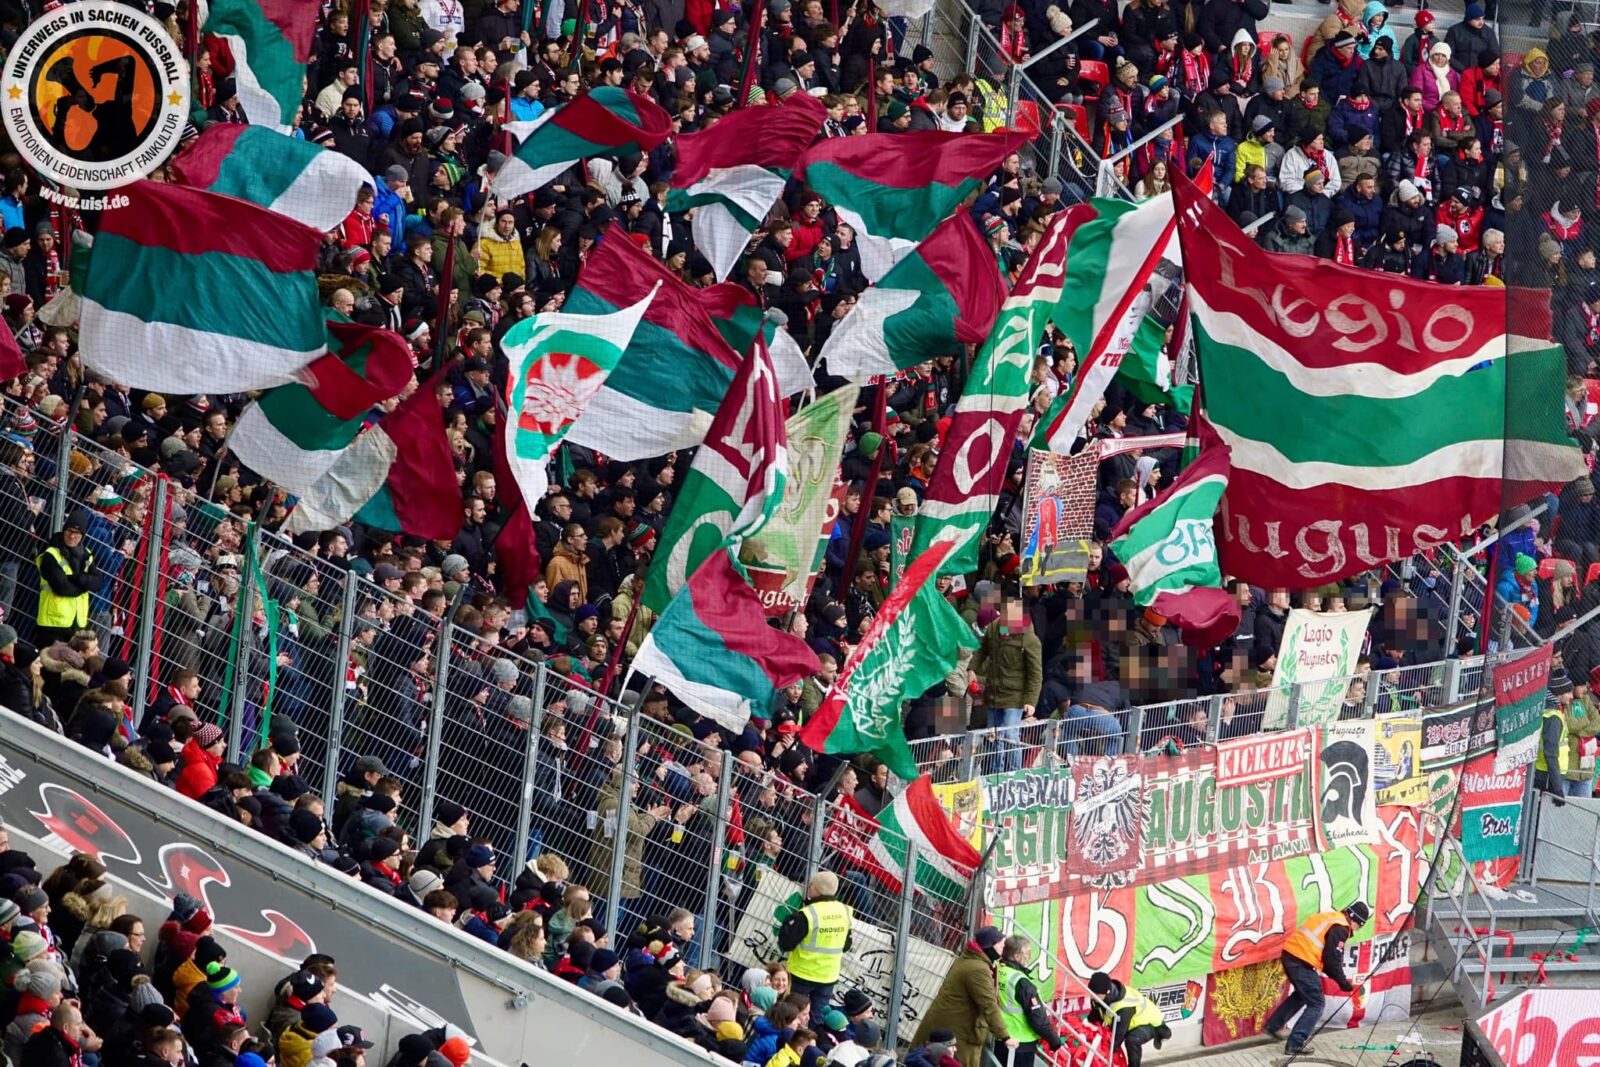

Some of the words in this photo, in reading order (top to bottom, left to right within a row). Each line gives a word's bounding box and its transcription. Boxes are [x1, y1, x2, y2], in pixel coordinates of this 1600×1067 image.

[1208, 229, 1474, 353] Legio
[1303, 623, 1334, 646] Legio
[1218, 735, 1306, 779] KICKERS
[988, 772, 1070, 815] LUSTENAU
[1480, 811, 1514, 839] Bros.
